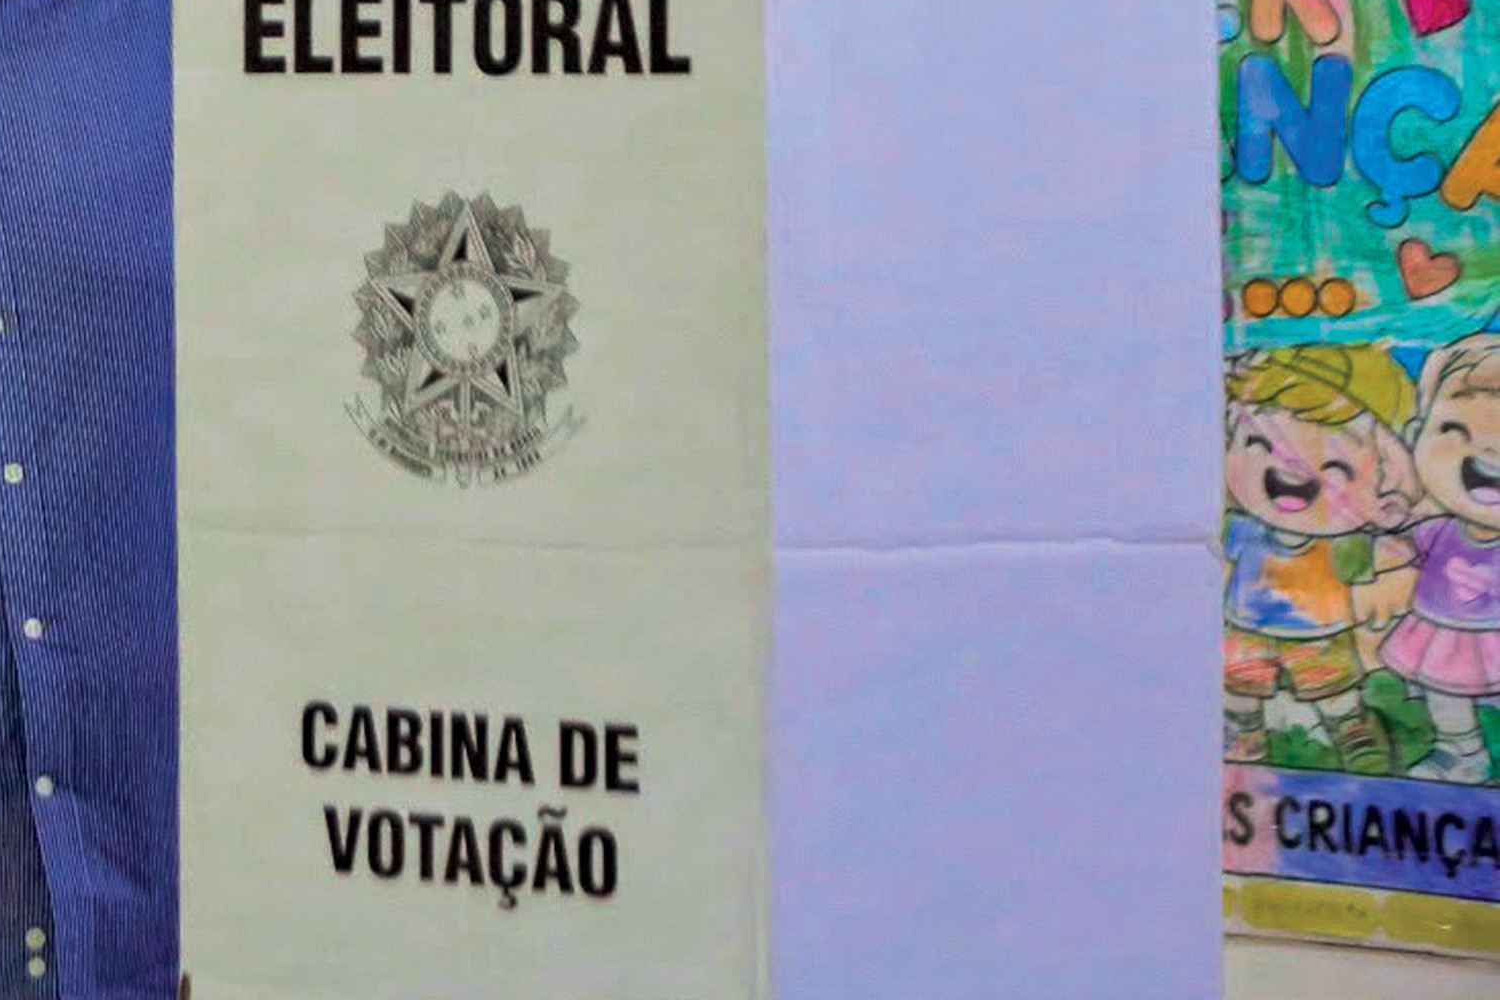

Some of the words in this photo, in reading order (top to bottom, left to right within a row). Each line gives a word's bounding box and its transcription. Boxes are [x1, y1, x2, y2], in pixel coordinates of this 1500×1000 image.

[300, 699, 535, 786] CABINA
[558, 718, 640, 793] DE
[323, 802, 618, 911] VOTAÇÃO
[1223, 790, 1255, 846] S
